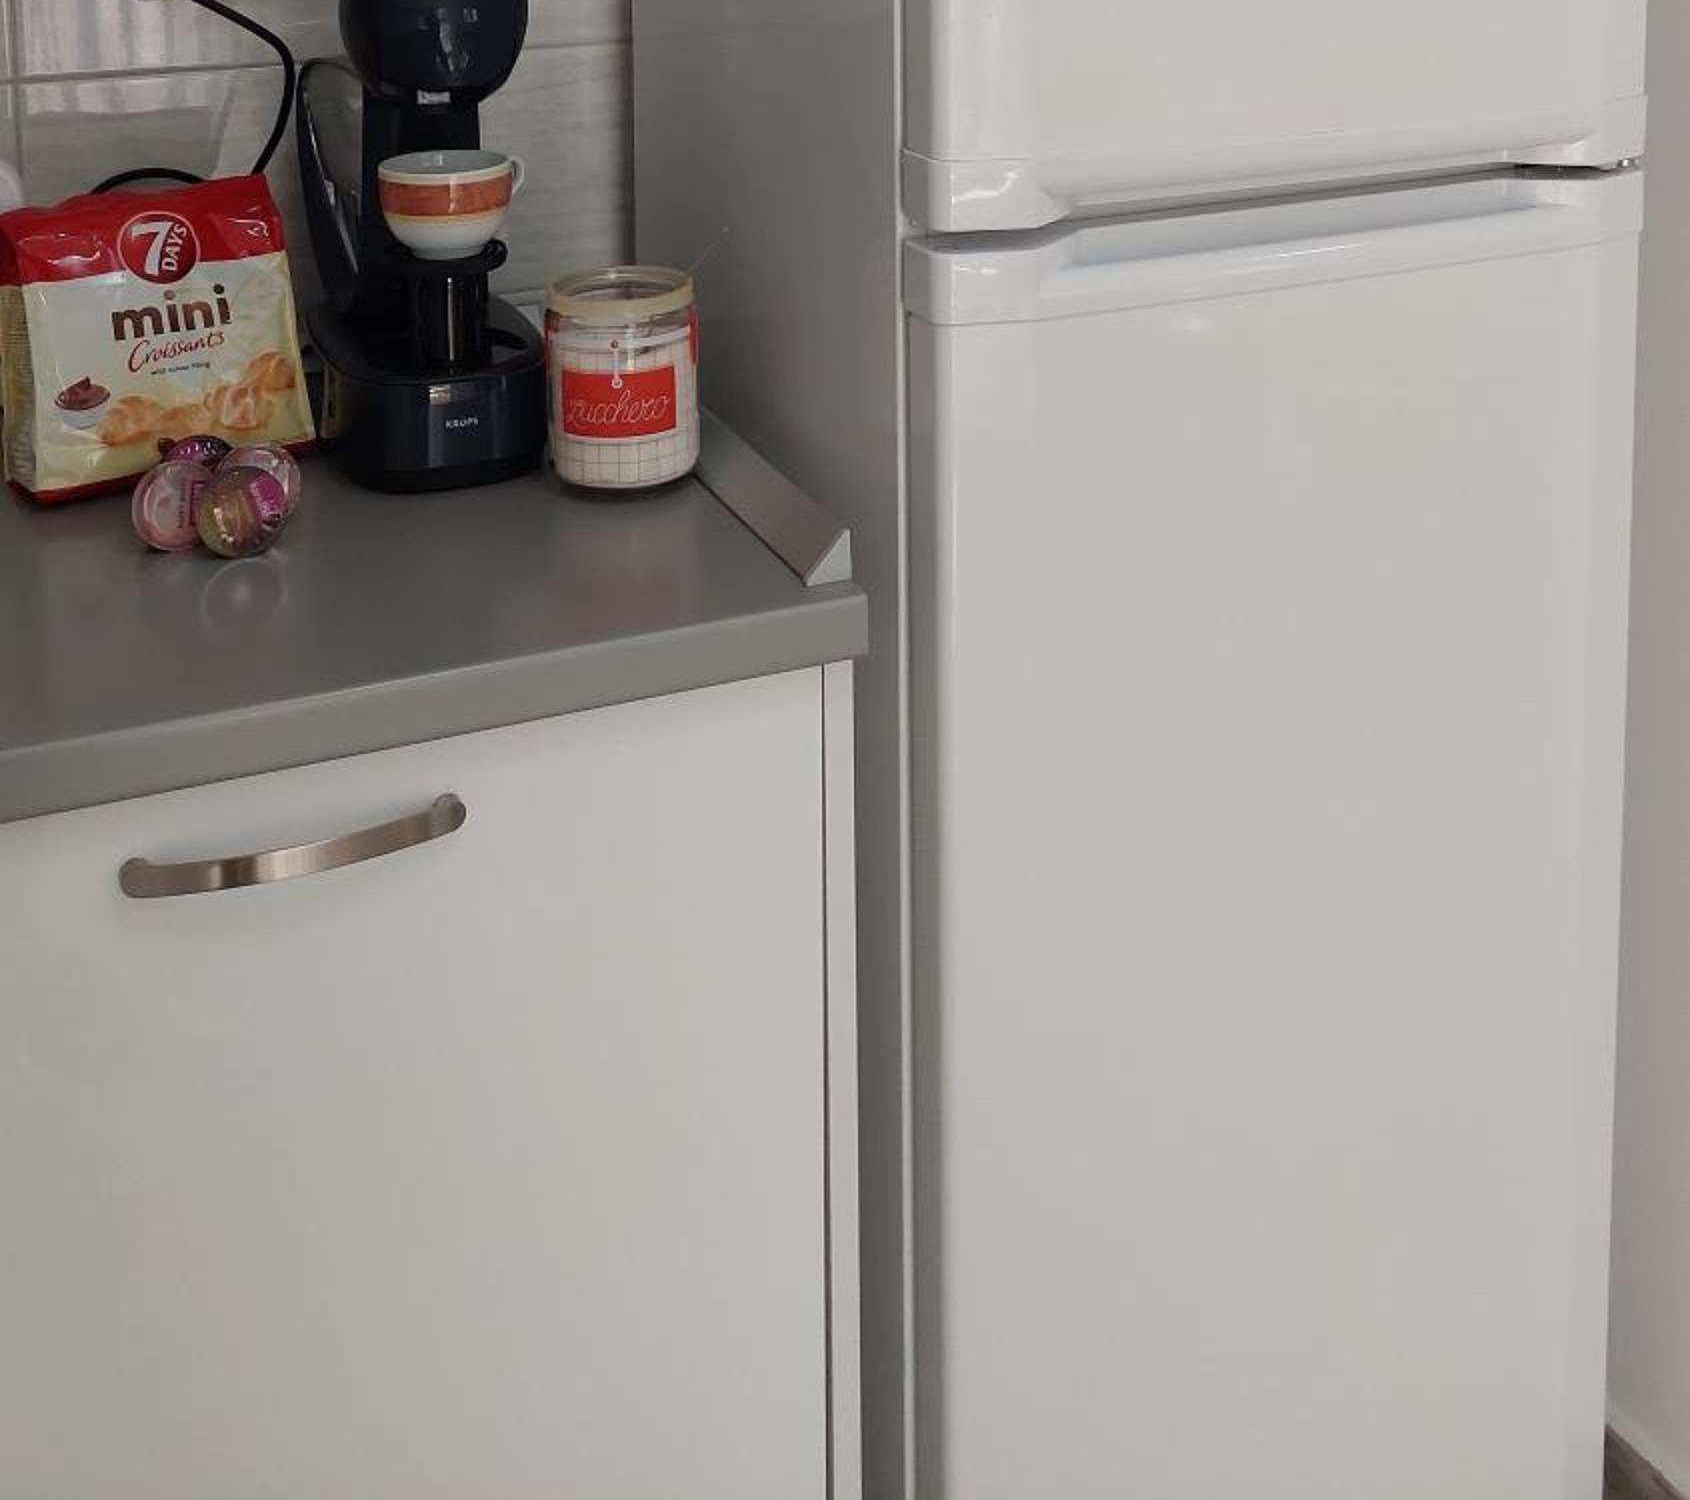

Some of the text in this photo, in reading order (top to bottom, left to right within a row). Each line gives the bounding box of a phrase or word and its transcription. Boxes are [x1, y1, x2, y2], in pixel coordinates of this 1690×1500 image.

[131, 221, 174, 276] 7
[161, 223, 187, 272] DAYS
[111, 283, 232, 341] mini
[127, 331, 225, 373] Croissants
